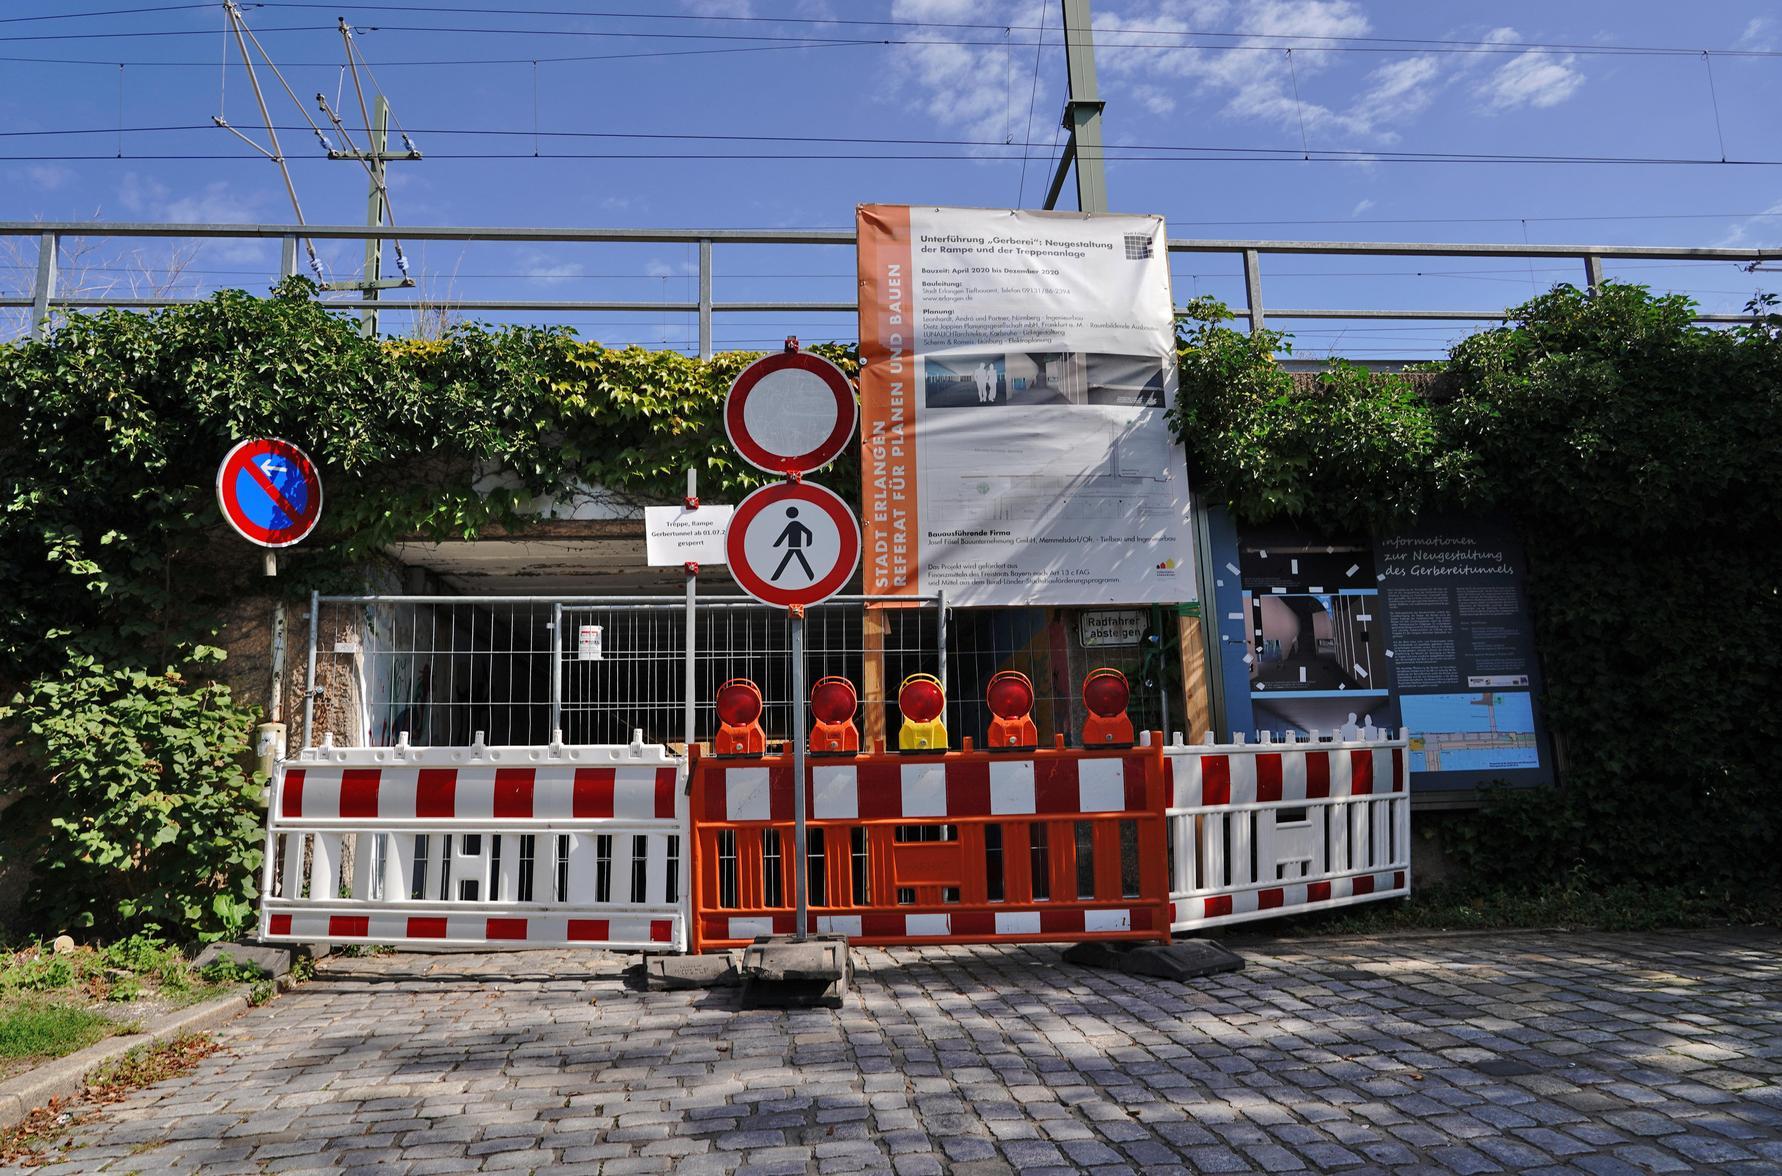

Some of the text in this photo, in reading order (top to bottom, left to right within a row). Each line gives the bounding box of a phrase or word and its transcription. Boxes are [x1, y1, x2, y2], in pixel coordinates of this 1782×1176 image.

[920, 235, 1113, 250] Unterführung „Gerberei“: Neugestaltung
[921, 245, 937, 253] der
[940, 246, 974, 255] Rampe
[1016, 248, 1086, 259] Treppenanlage
[952, 267, 970, 275] April
[888, 264, 907, 587] REFERAT FÜR PLANEN UND BAUEN
[873, 420, 889, 587] STADT ERLANGEN
[927, 530, 988, 538] Bauausführende
[1384, 549, 1503, 563] zur Neugestaltung
[941, 563, 962, 571] Projekt
[1384, 564, 1514, 577] des Gerbereitunnels
[1010, 570, 1032, 578] Bayern
[1088, 617, 1141, 628] Radfahrer
